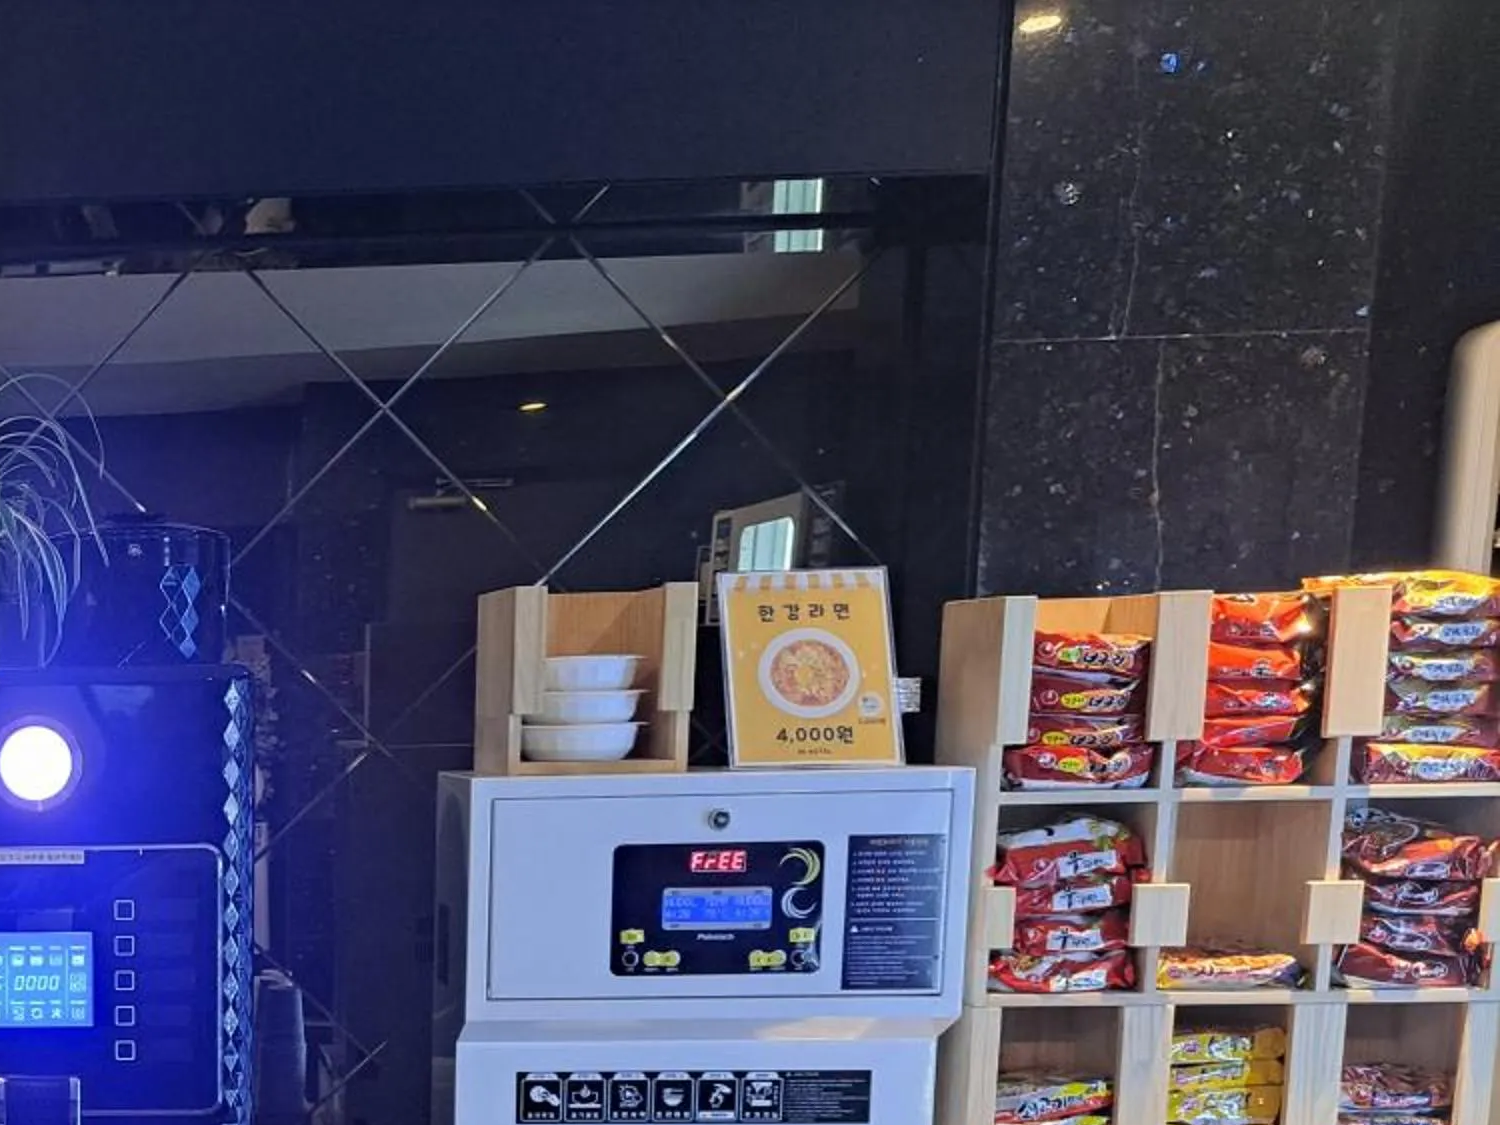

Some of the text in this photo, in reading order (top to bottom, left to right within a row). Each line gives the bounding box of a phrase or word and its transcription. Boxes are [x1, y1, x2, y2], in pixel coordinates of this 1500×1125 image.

[757, 603, 850, 623] 한강라면
[776, 726, 853, 744] 4,000원
[13, 975, 61, 991] 0000
